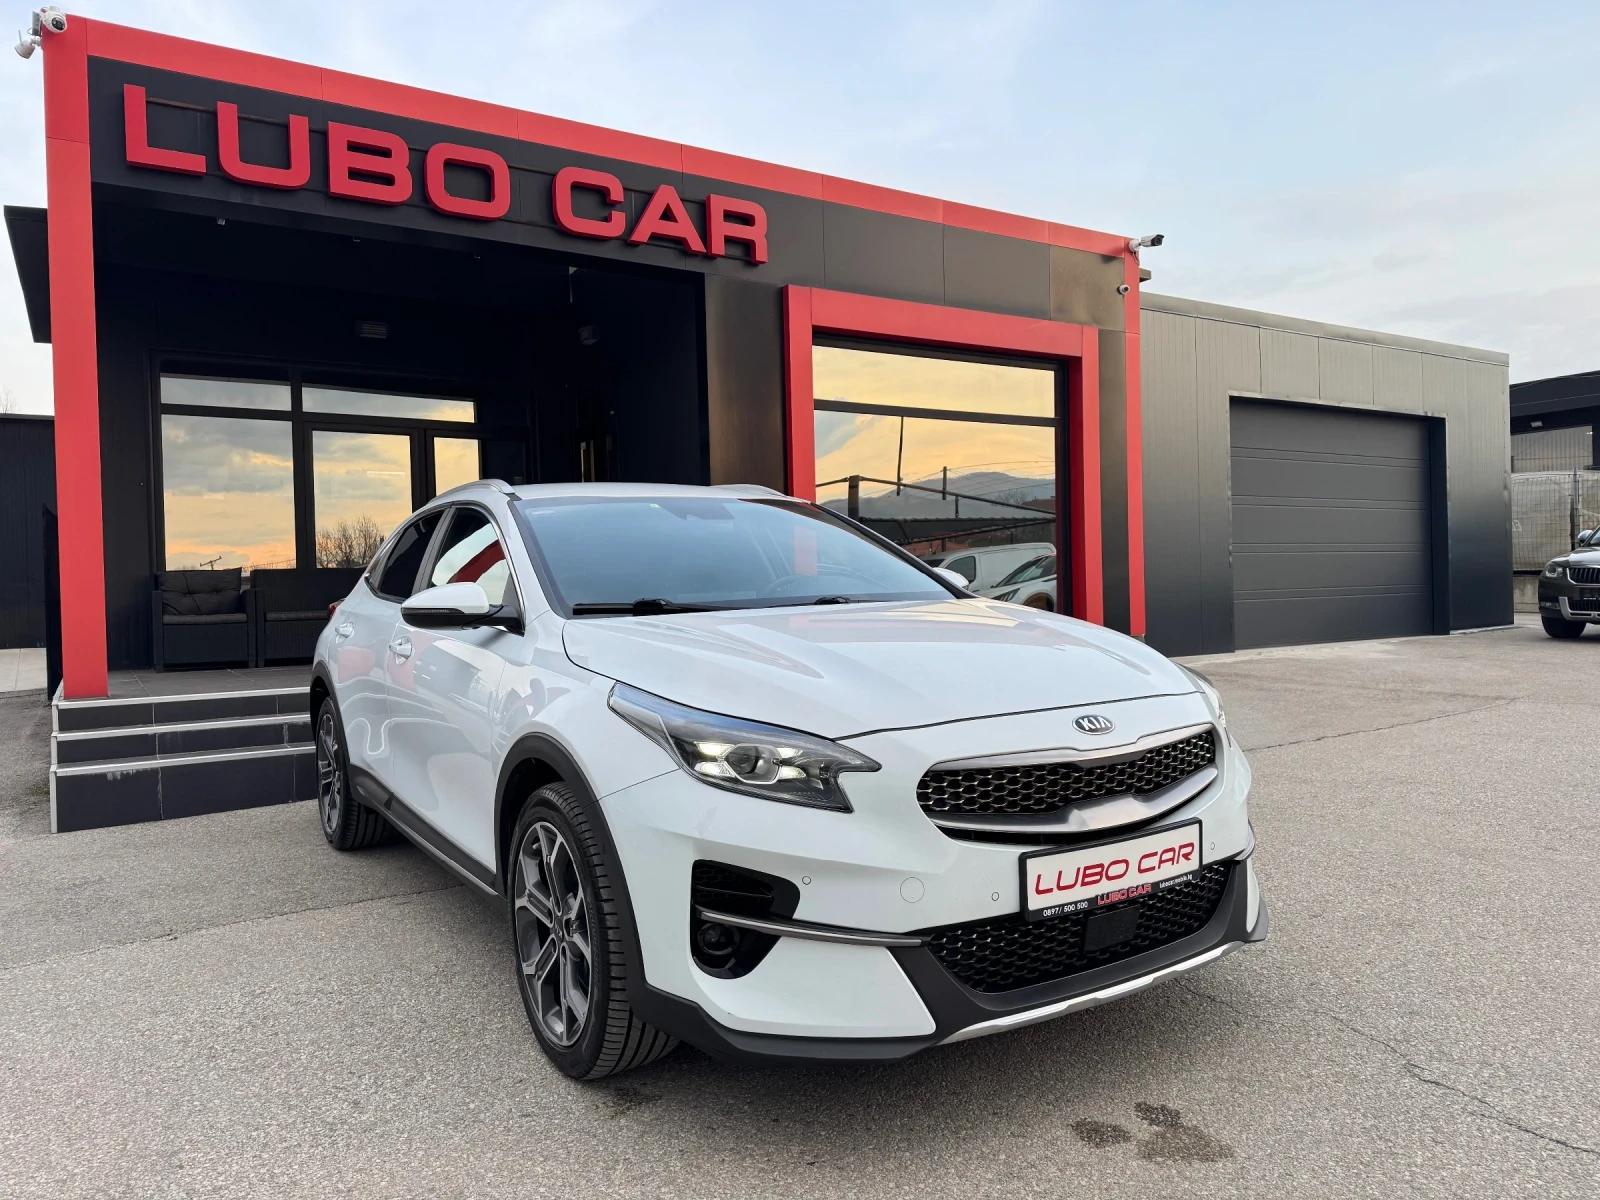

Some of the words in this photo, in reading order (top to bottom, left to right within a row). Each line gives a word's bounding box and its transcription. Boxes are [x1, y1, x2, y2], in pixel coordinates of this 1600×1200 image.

[123, 83, 511, 220] LUBO
[552, 166, 768, 264] CAR
[1077, 716, 1112, 730] KIA
[1034, 859, 1130, 896] LUBO
[1137, 841, 1195, 874] CAR
[1097, 887, 1128, 906] LUBO
[1128, 883, 1152, 897] CAR
[1063, 903, 1076, 914] 500
[1076, 901, 1088, 911] 500
